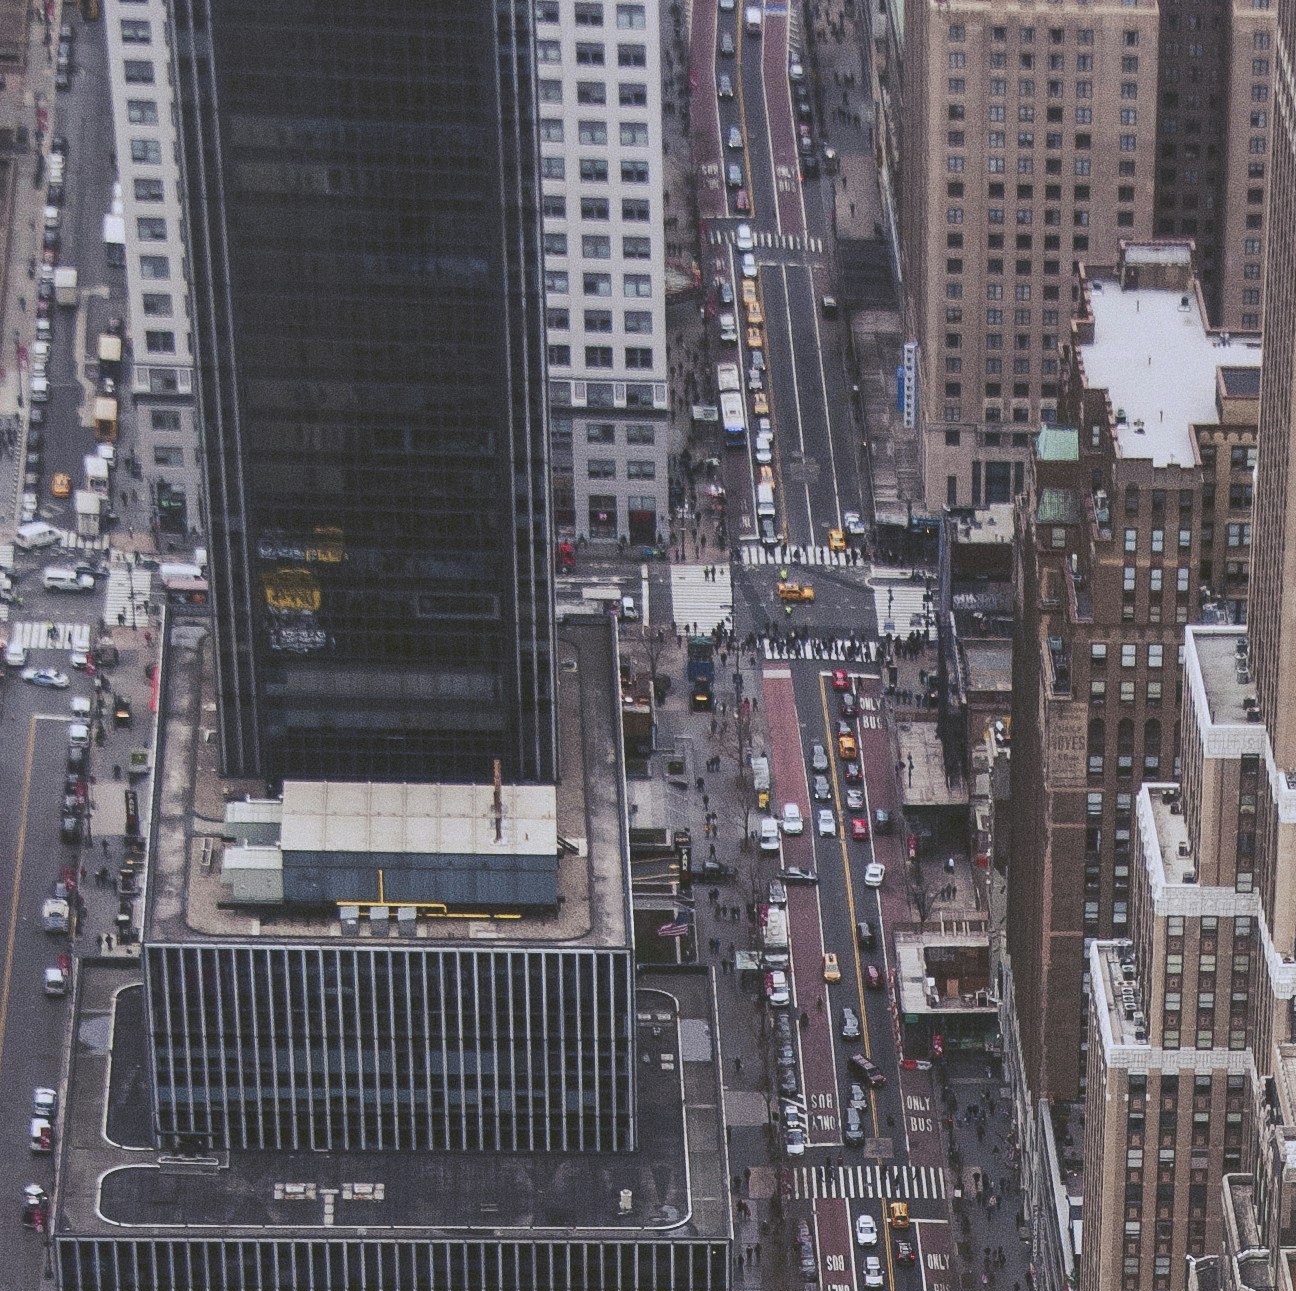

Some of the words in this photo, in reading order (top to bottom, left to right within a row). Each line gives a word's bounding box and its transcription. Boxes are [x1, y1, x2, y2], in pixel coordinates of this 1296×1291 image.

[860, 697, 881, 712] ONLY
[862, 716, 883, 730] BUS
[812, 1094, 833, 1109] BUS
[907, 1095, 931, 1111] ONLY
[812, 1116, 836, 1130] ONLY
[911, 1117, 933, 1132] BUS
[827, 1255, 845, 1271] BUS
[927, 1253, 950, 1270] ONLY
